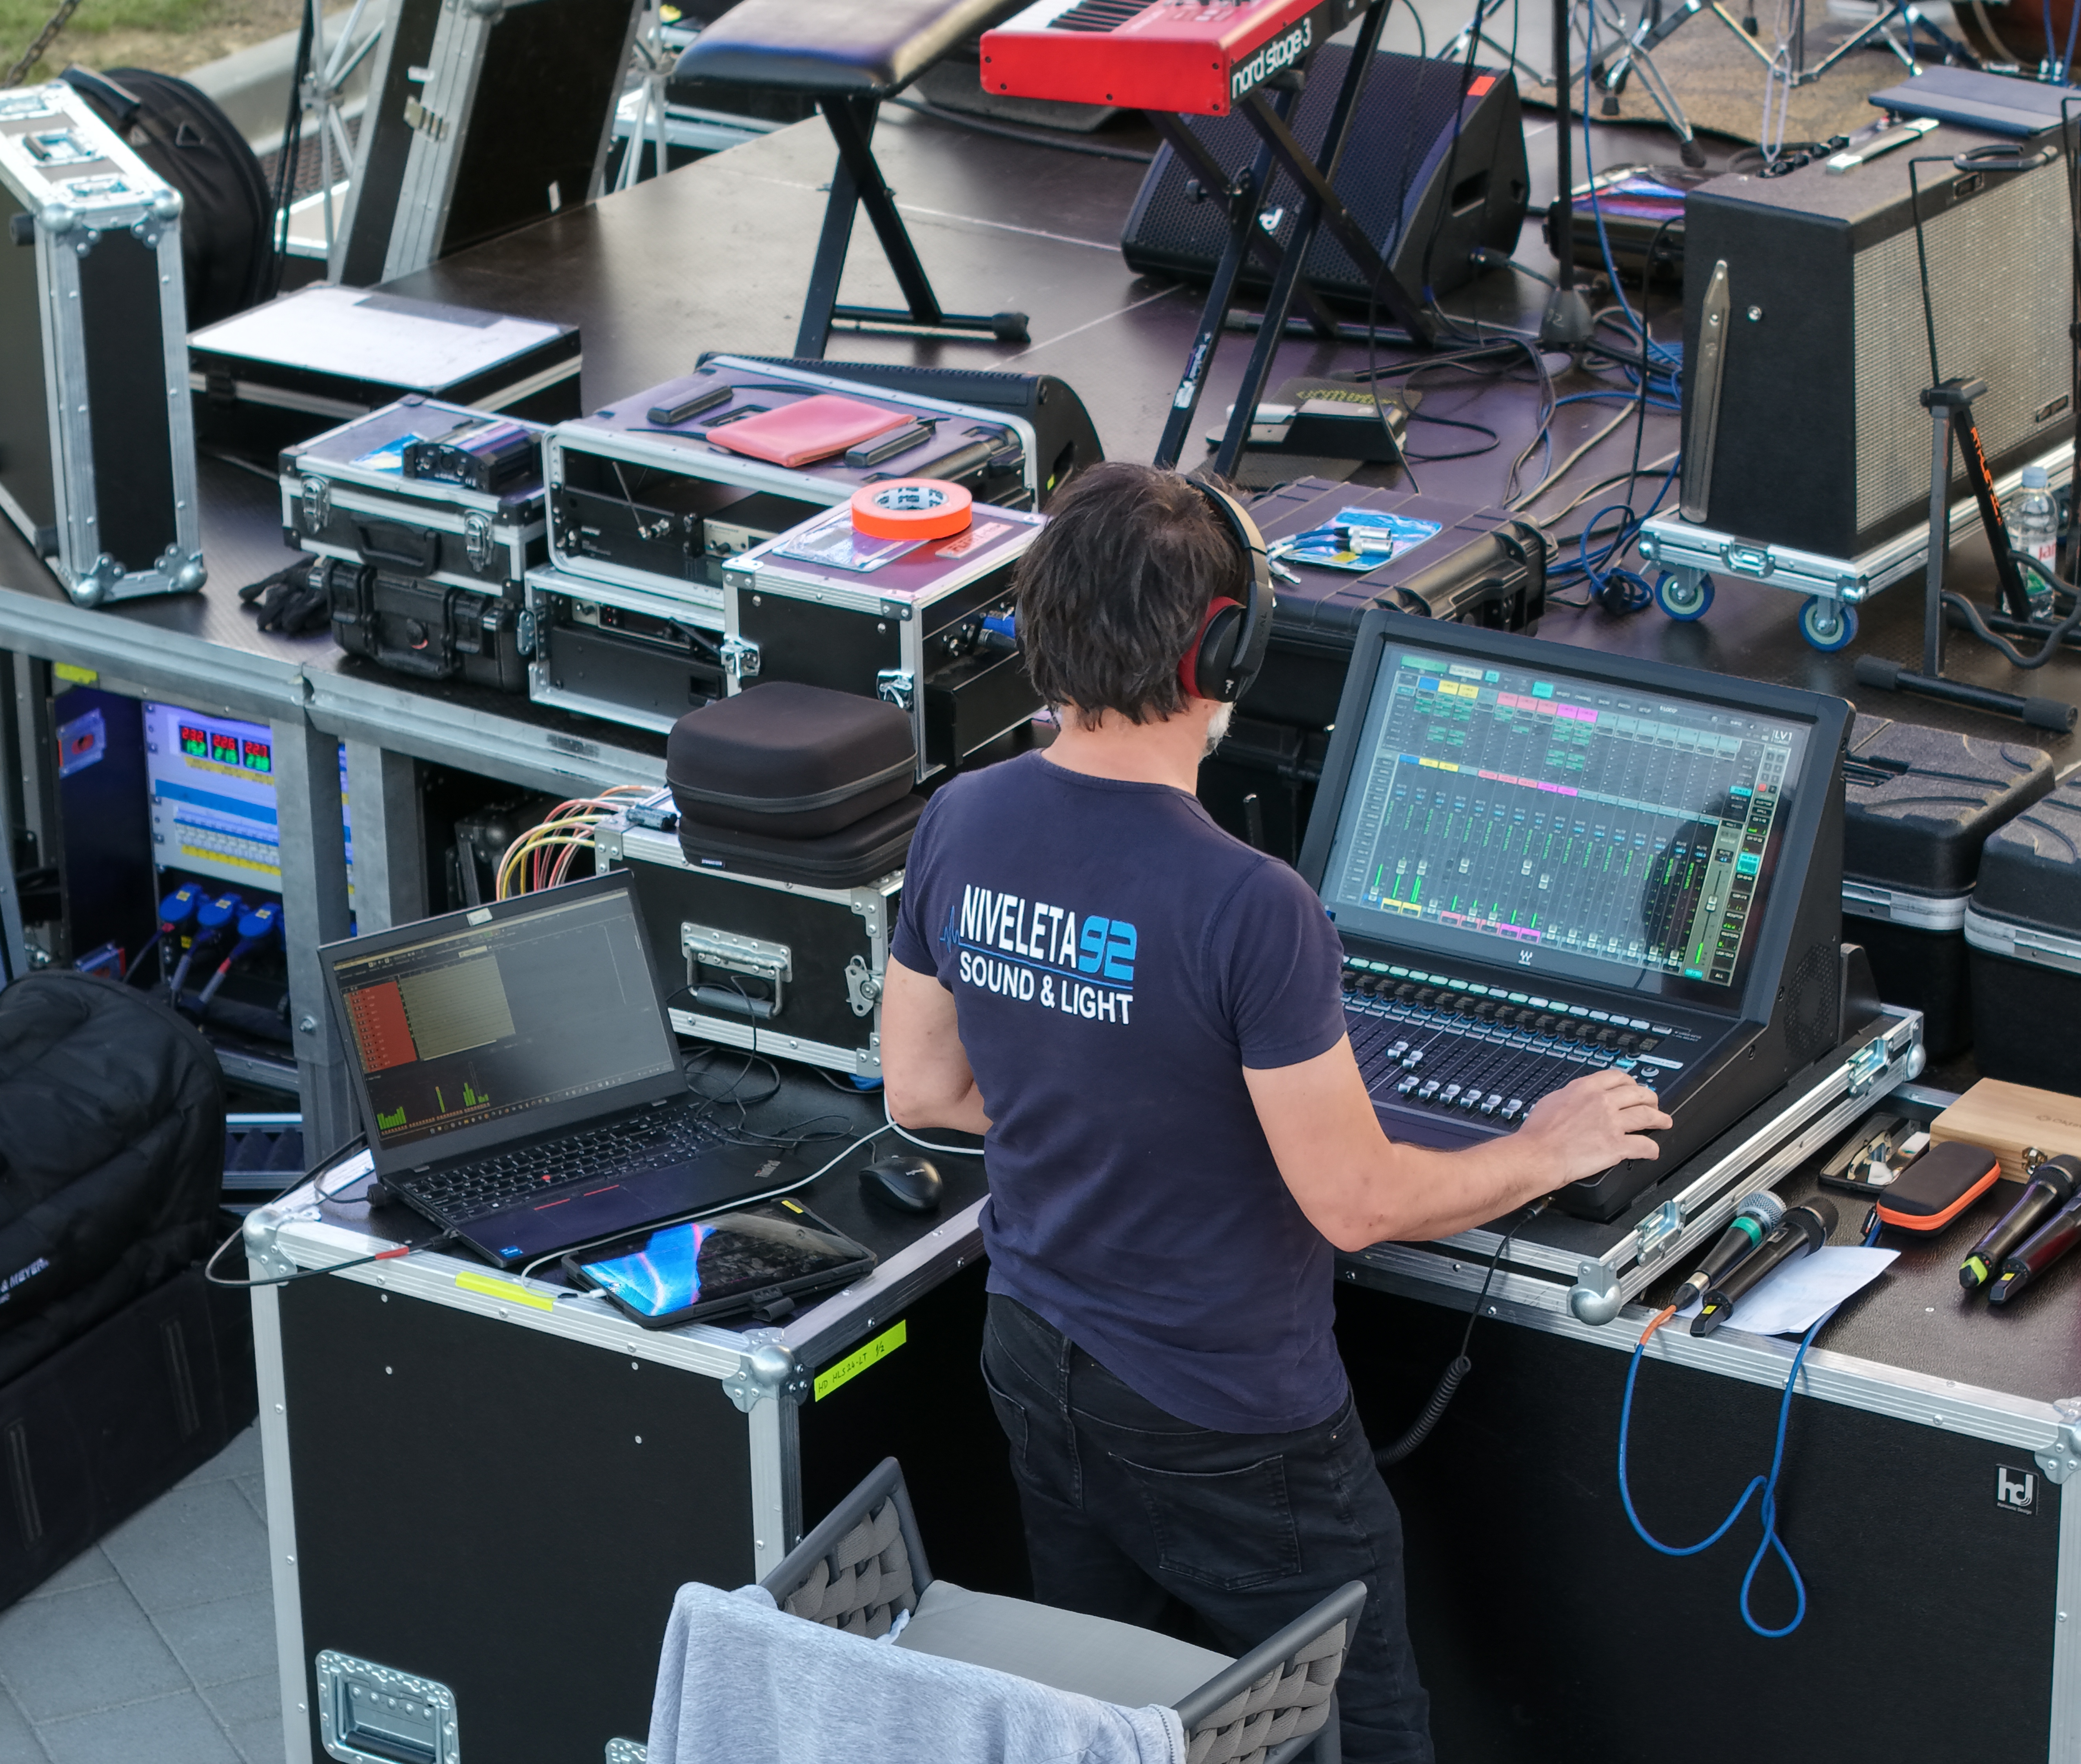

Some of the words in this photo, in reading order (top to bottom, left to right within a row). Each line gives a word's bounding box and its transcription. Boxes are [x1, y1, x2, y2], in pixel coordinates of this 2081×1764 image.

[1231, 50, 1265, 100] nord
[1265, 28, 1302, 74] stage
[1302, 17, 1312, 47] 3
[182, 728, 204, 742] 232
[213, 734, 235, 750] 226
[1774, 730, 1792, 741] LV1
[245, 741, 268, 757] 227
[960, 884, 1077, 968] NIVELETA
[1078, 915, 1137, 981] 92
[960, 951, 1035, 1001] SOUND
[1040, 975, 1055, 1008] &
[1061, 980, 1133, 1025] LIGHT
[819, 1380, 828, 1393] HD
